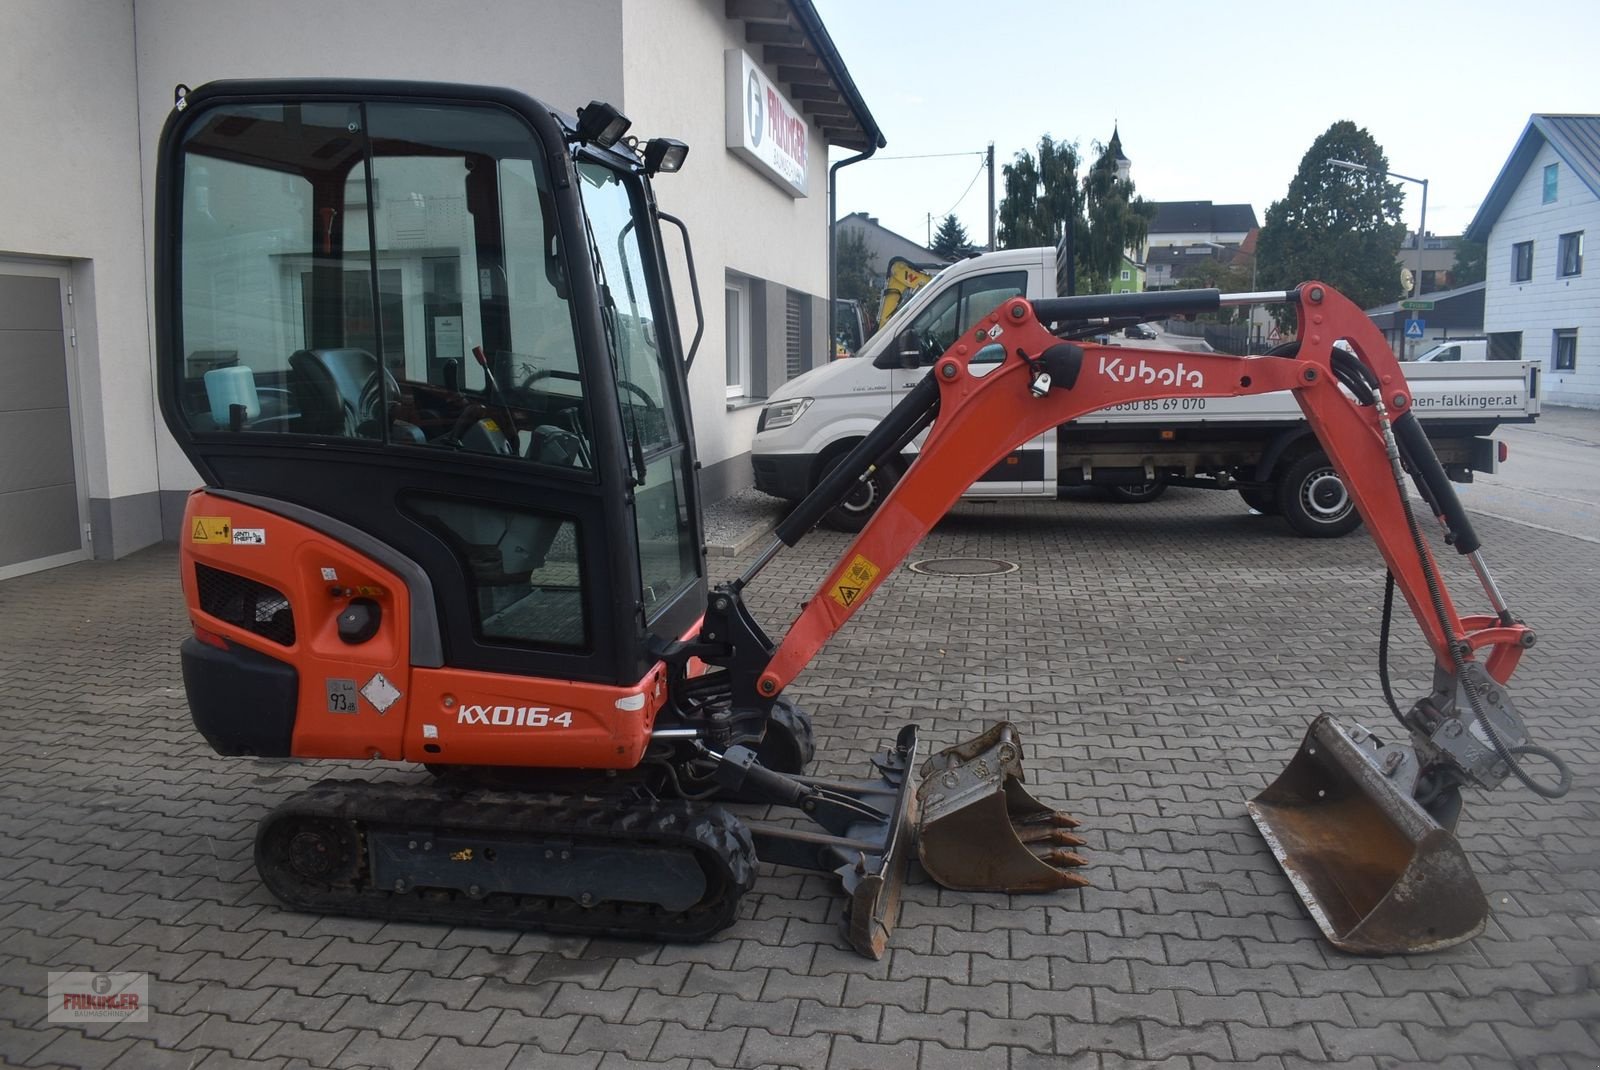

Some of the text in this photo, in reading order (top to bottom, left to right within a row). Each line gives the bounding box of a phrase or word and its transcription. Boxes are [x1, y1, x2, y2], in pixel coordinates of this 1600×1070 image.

[1098, 356, 1204, 388] Kubota
[1143, 399, 1159, 410] 85
[1163, 398, 1178, 410] 69
[1182, 398, 1206, 409] 070
[330, 693, 347, 710] 93
[457, 705, 573, 728] KX016-4
